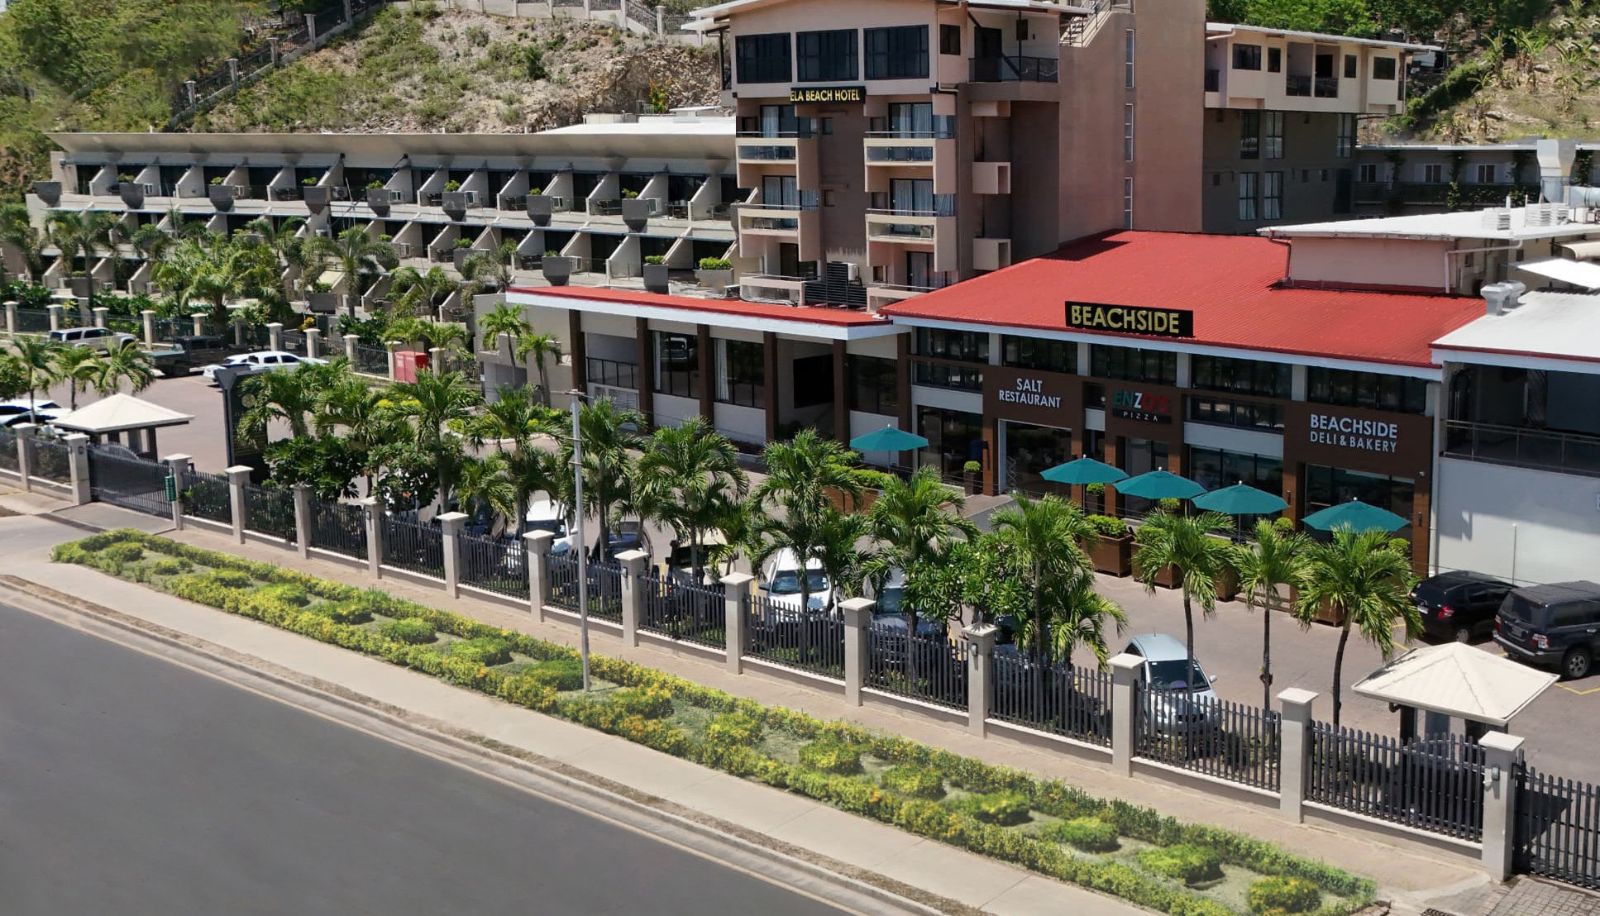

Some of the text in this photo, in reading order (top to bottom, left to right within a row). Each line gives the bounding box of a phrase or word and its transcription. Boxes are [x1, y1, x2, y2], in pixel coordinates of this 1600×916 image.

[790, 89, 860, 102] ELA BEACH HOTEL
[1071, 306, 1180, 334] BEACHSIDE
[1016, 378, 1042, 392] SALT
[999, 390, 1061, 408] RESTAURANT
[1122, 411, 1158, 421] PIZZA
[1310, 414, 1398, 438] BEACHSIDE
